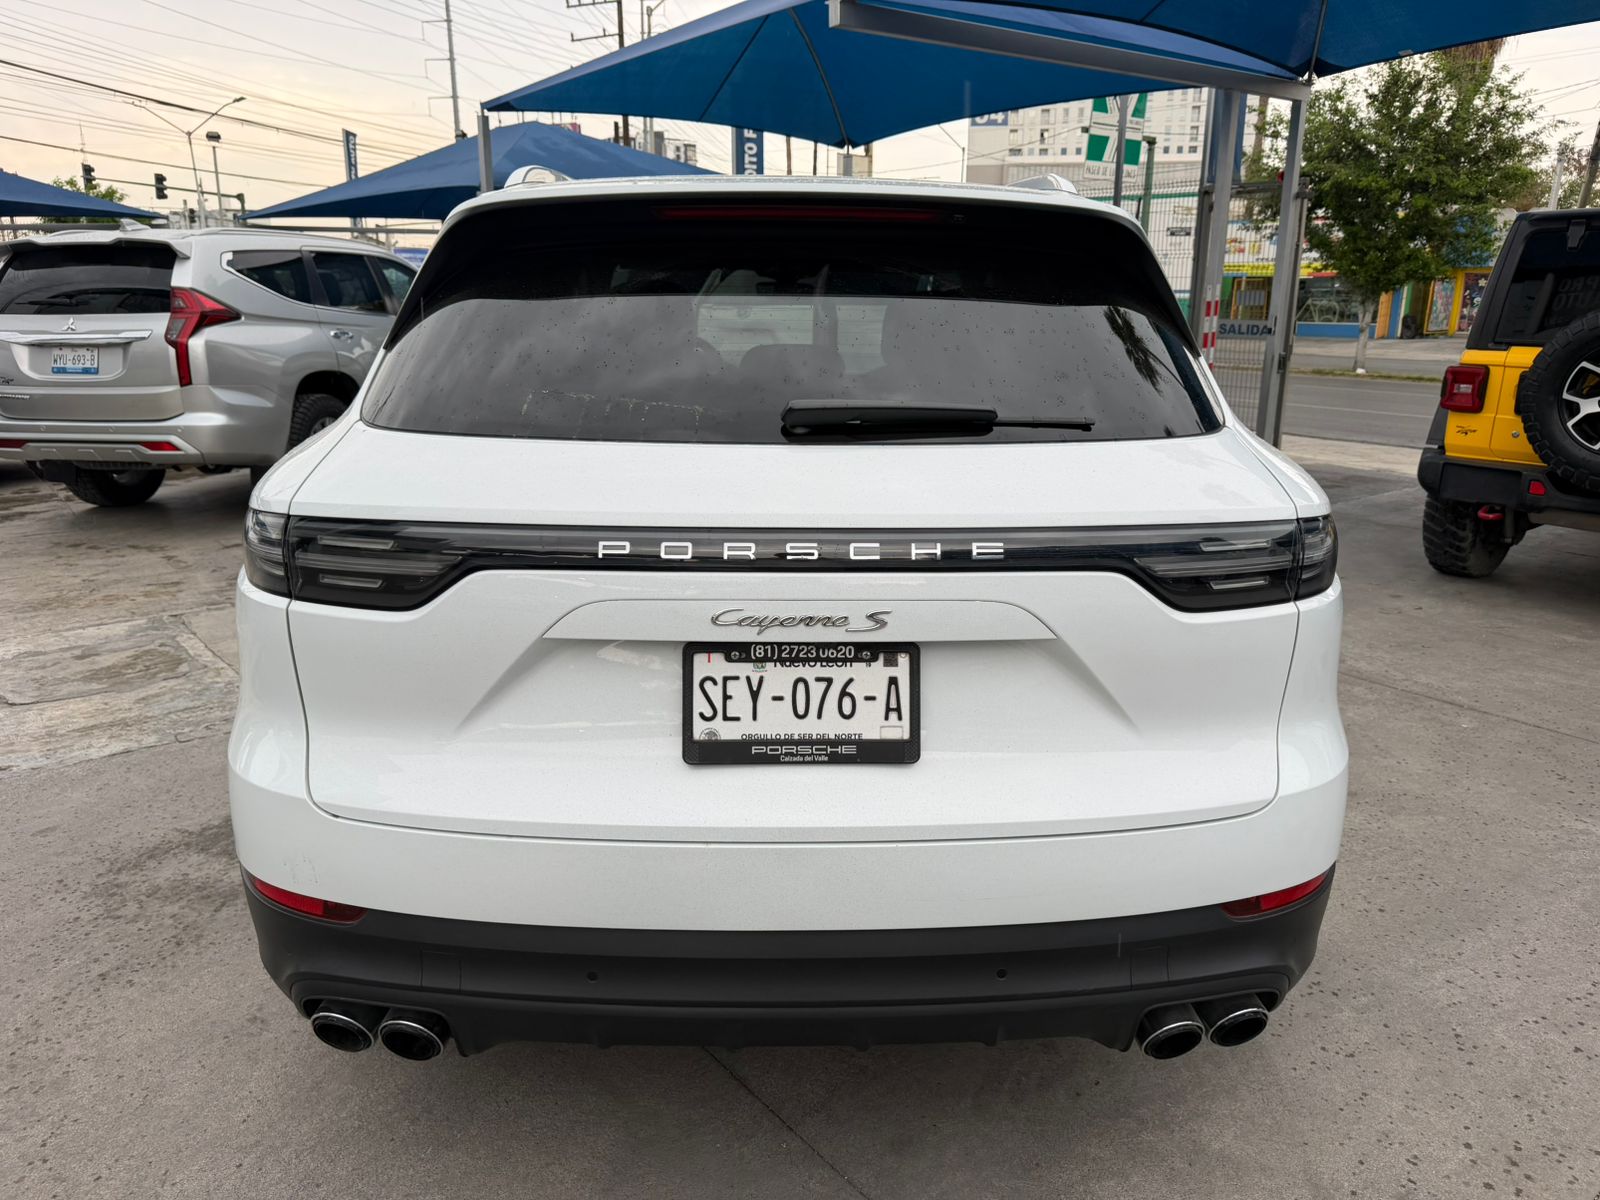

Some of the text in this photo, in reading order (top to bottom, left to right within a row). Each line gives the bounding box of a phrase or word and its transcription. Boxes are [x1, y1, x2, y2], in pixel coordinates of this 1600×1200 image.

[1218, 323, 1269, 336] SALIDA
[53, 353, 95, 367] WYU-693-B
[597, 541, 1005, 560] PORSCHE
[711, 608, 893, 636] Cayenne S
[750, 644, 778, 660] (81)
[781, 645, 816, 658] 2723
[698, 675, 904, 722] SEY-076-A
[751, 745, 857, 755] PORSCHE
